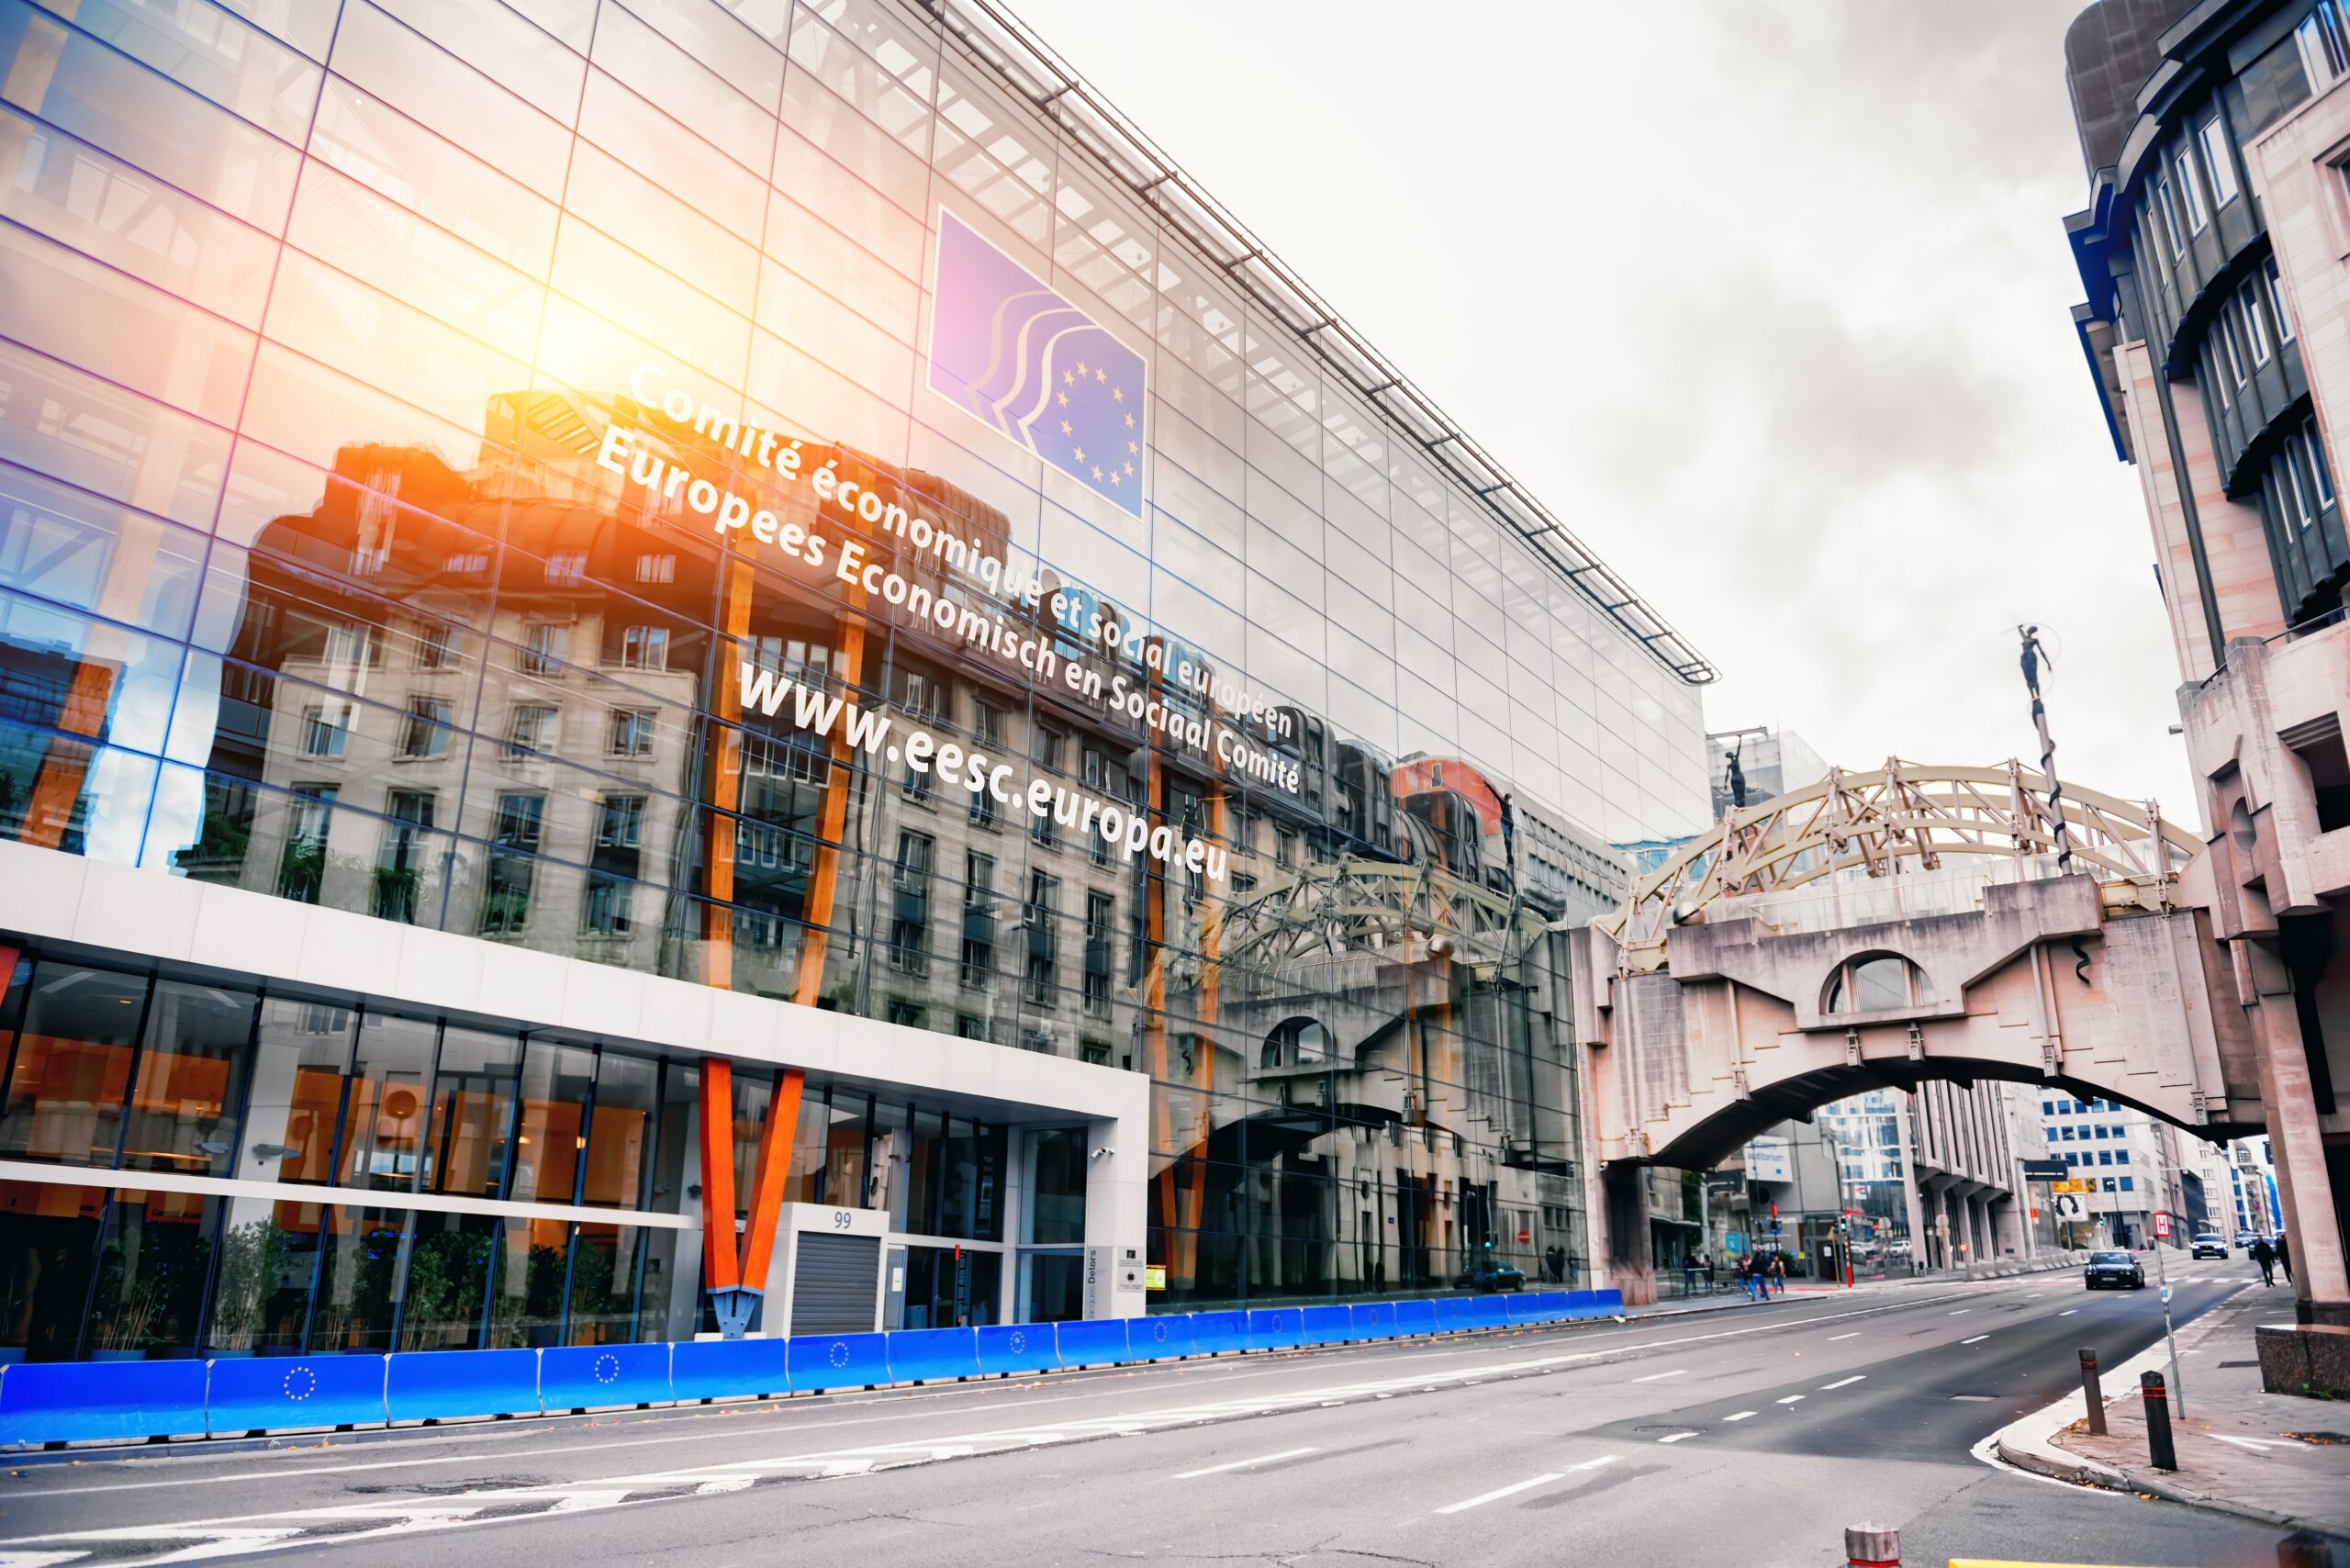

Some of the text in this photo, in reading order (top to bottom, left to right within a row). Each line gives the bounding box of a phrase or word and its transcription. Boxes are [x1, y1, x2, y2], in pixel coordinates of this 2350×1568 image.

[596, 423, 1300, 794] Europees Economisch en Sociaal Comité
[630, 363, 1292, 738] Comité économique et social européen
[740, 661, 1227, 882] www.eesc.europa.eu
[834, 1212, 852, 1229] 99
[1748, 1153, 1785, 1161] auditorium
[1088, 1249, 1096, 1284] Delors
